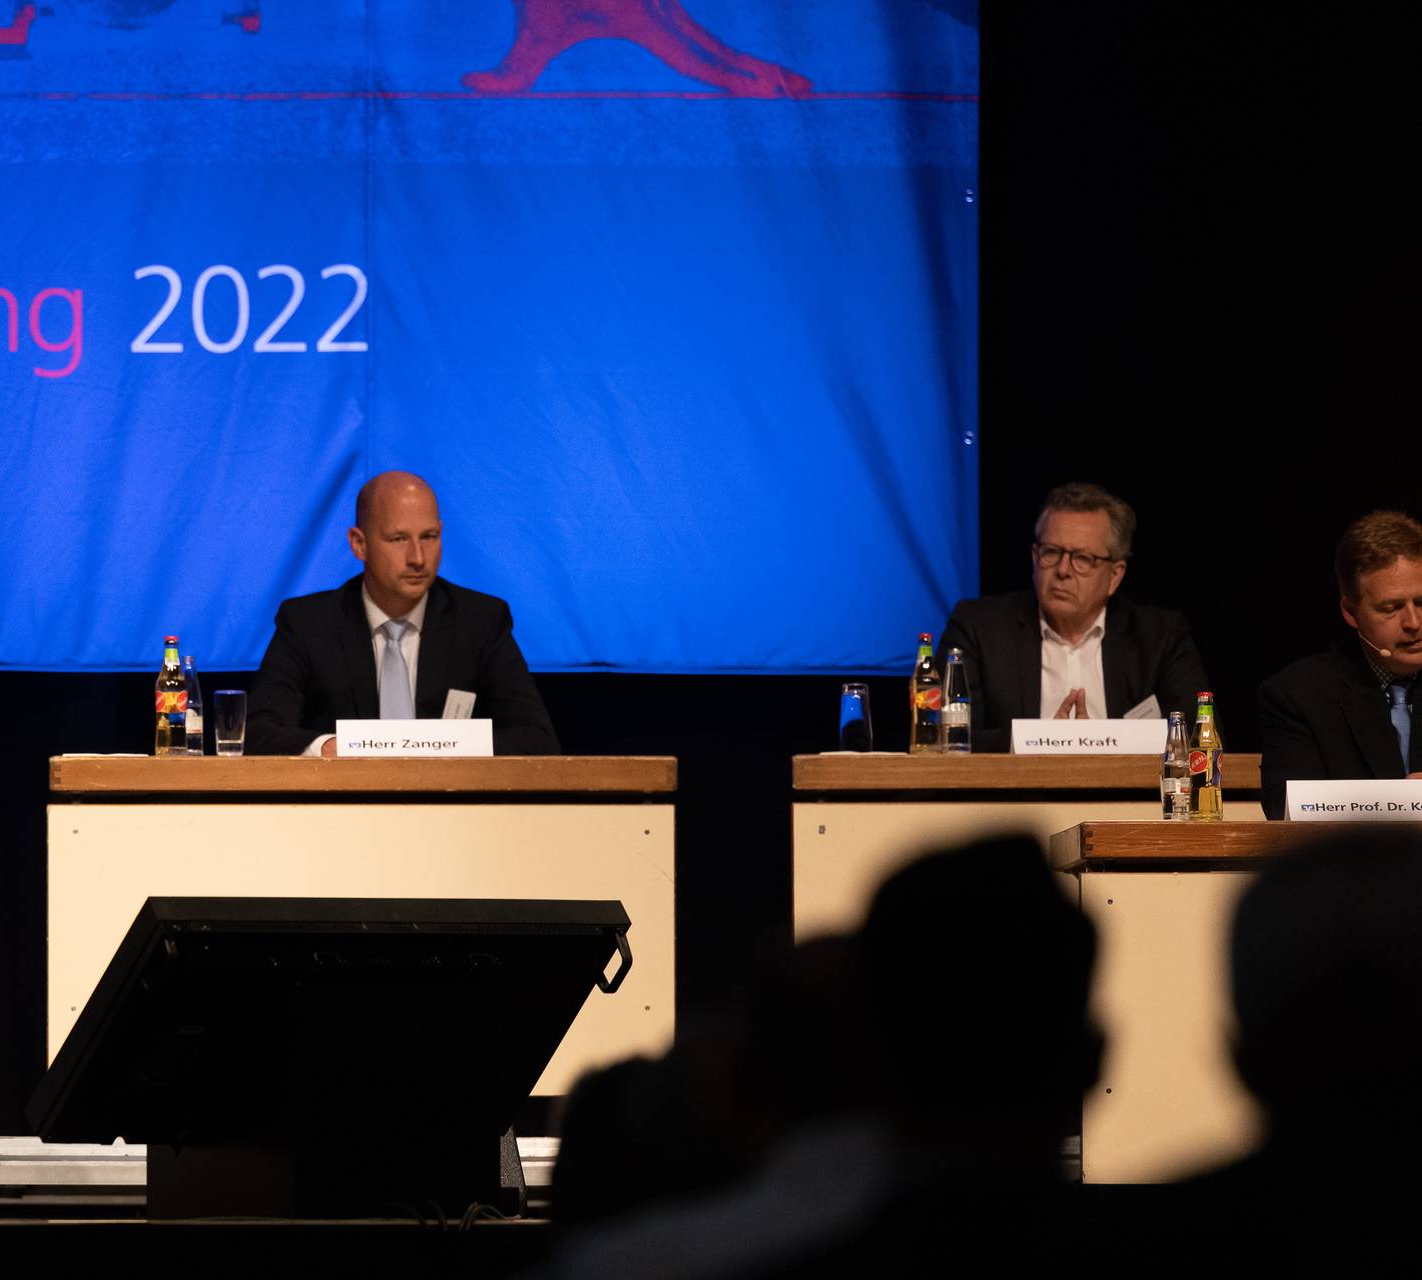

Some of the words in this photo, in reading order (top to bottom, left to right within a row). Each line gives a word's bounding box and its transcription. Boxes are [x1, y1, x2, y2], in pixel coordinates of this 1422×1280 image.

[131, 264, 368, 354] 2022
[362, 739, 396, 749] Herr
[402, 739, 458, 750] Zanger
[1039, 738, 1074, 746] Herr
[1079, 737, 1119, 746] Kraft
[1316, 803, 1346, 811] Herr
[1351, 802, 1382, 811] Prof.
[1387, 802, 1407, 811] Dr.
